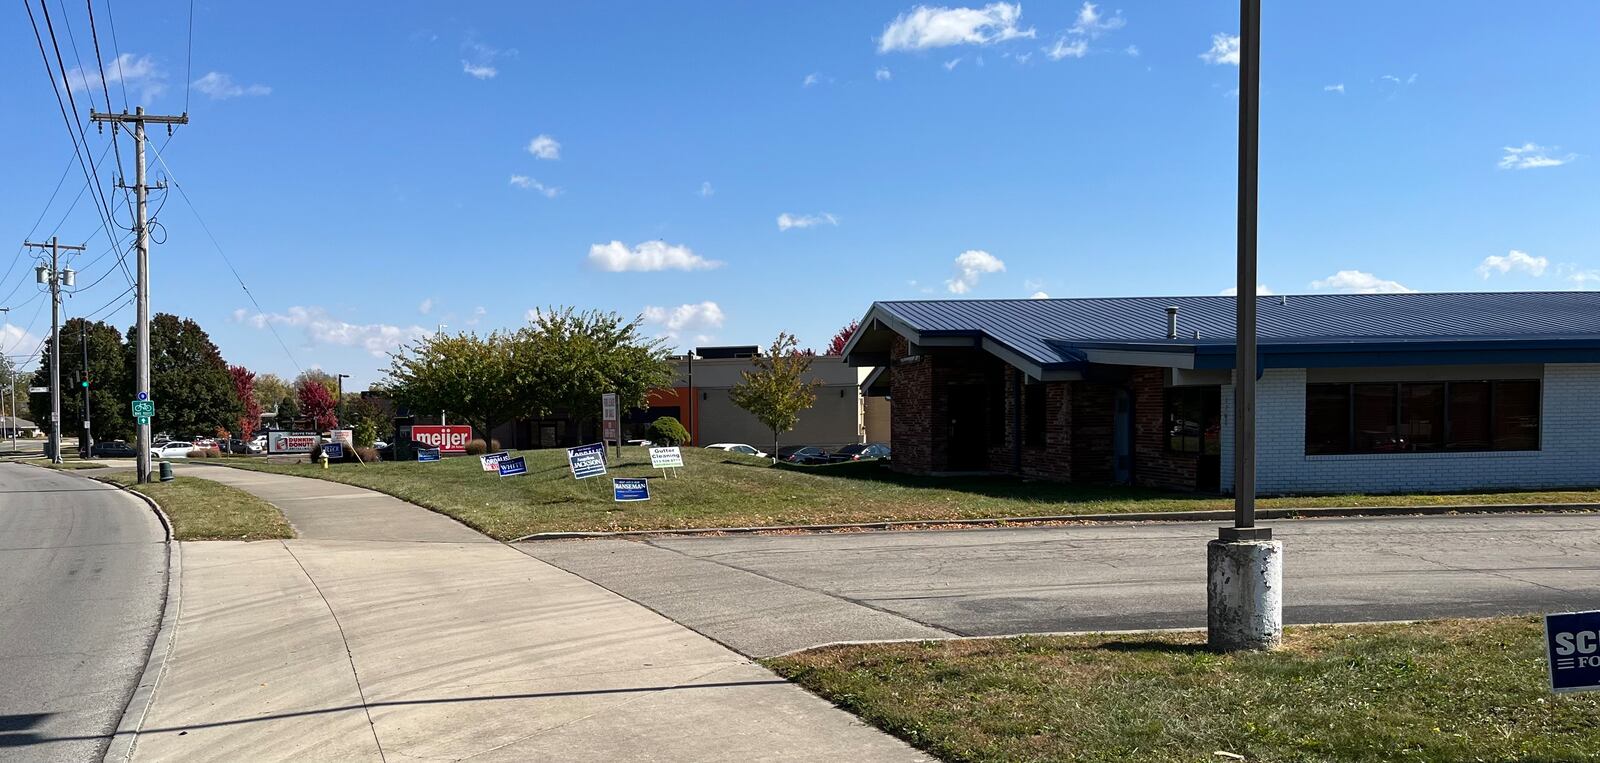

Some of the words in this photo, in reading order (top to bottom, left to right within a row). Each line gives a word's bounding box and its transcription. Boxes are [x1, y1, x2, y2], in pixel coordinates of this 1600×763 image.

[416, 428, 468, 449] meijer
[500, 461, 524, 471] WHITE
[573, 459, 602, 468] JACKSON
[1555, 630, 1600, 656] SC
